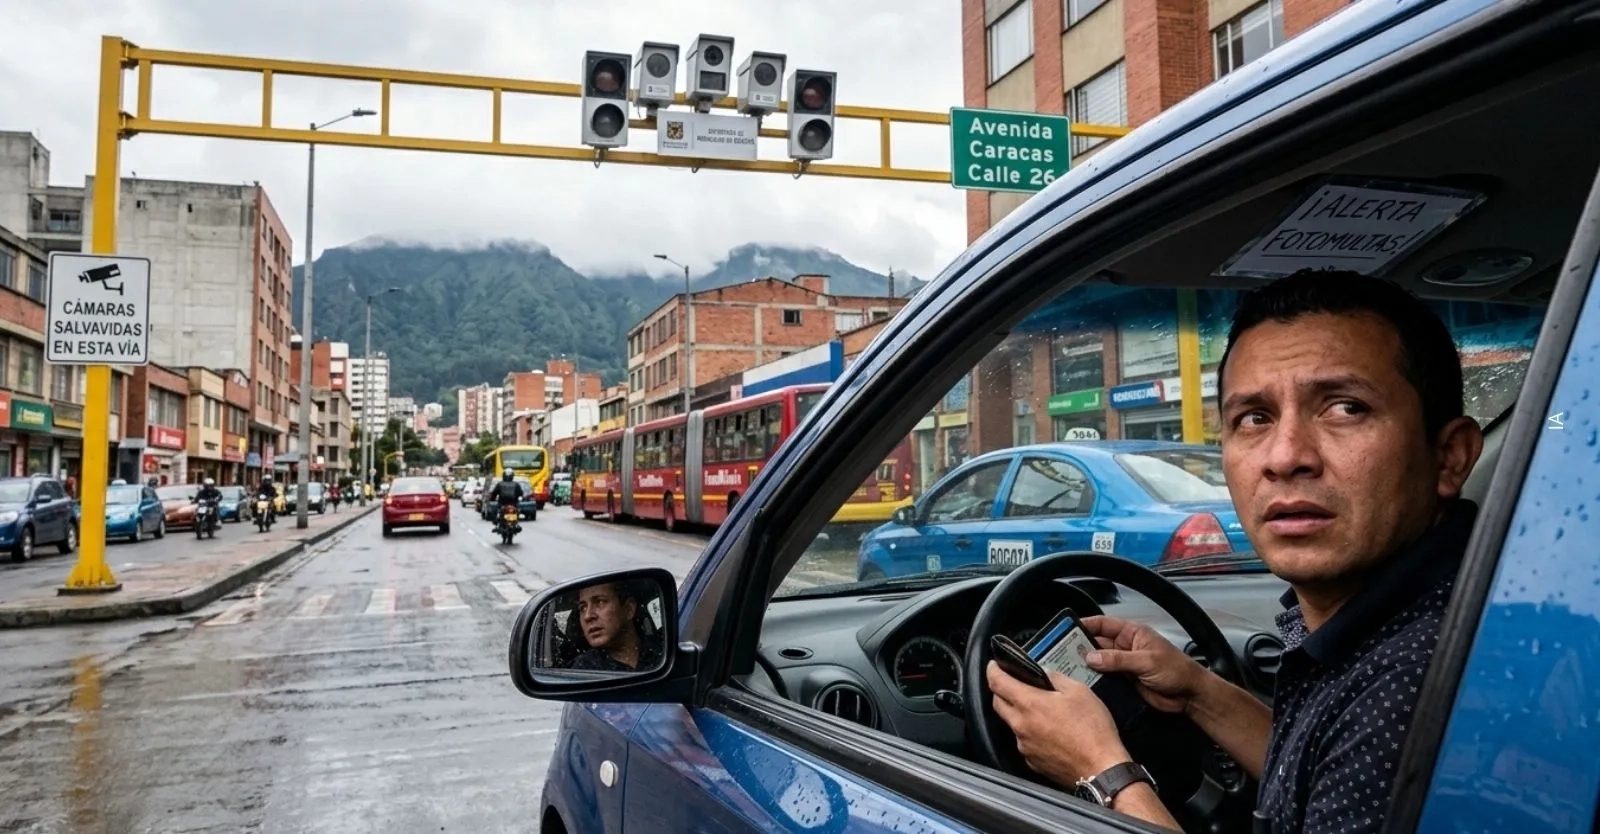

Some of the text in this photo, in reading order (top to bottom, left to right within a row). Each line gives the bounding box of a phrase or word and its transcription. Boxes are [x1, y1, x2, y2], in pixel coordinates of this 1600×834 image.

[969, 117, 1053, 140] Avenida
[969, 140, 1054, 163] Caracas
[968, 163, 1056, 186] Calle 26
[1262, 229, 1424, 255] FOTOMULTAS!
[63, 298, 135, 317] CÁMARAS
[54, 320, 142, 336] SALVAVIDAS
[54, 339, 141, 356] EN ESTA VÍA
